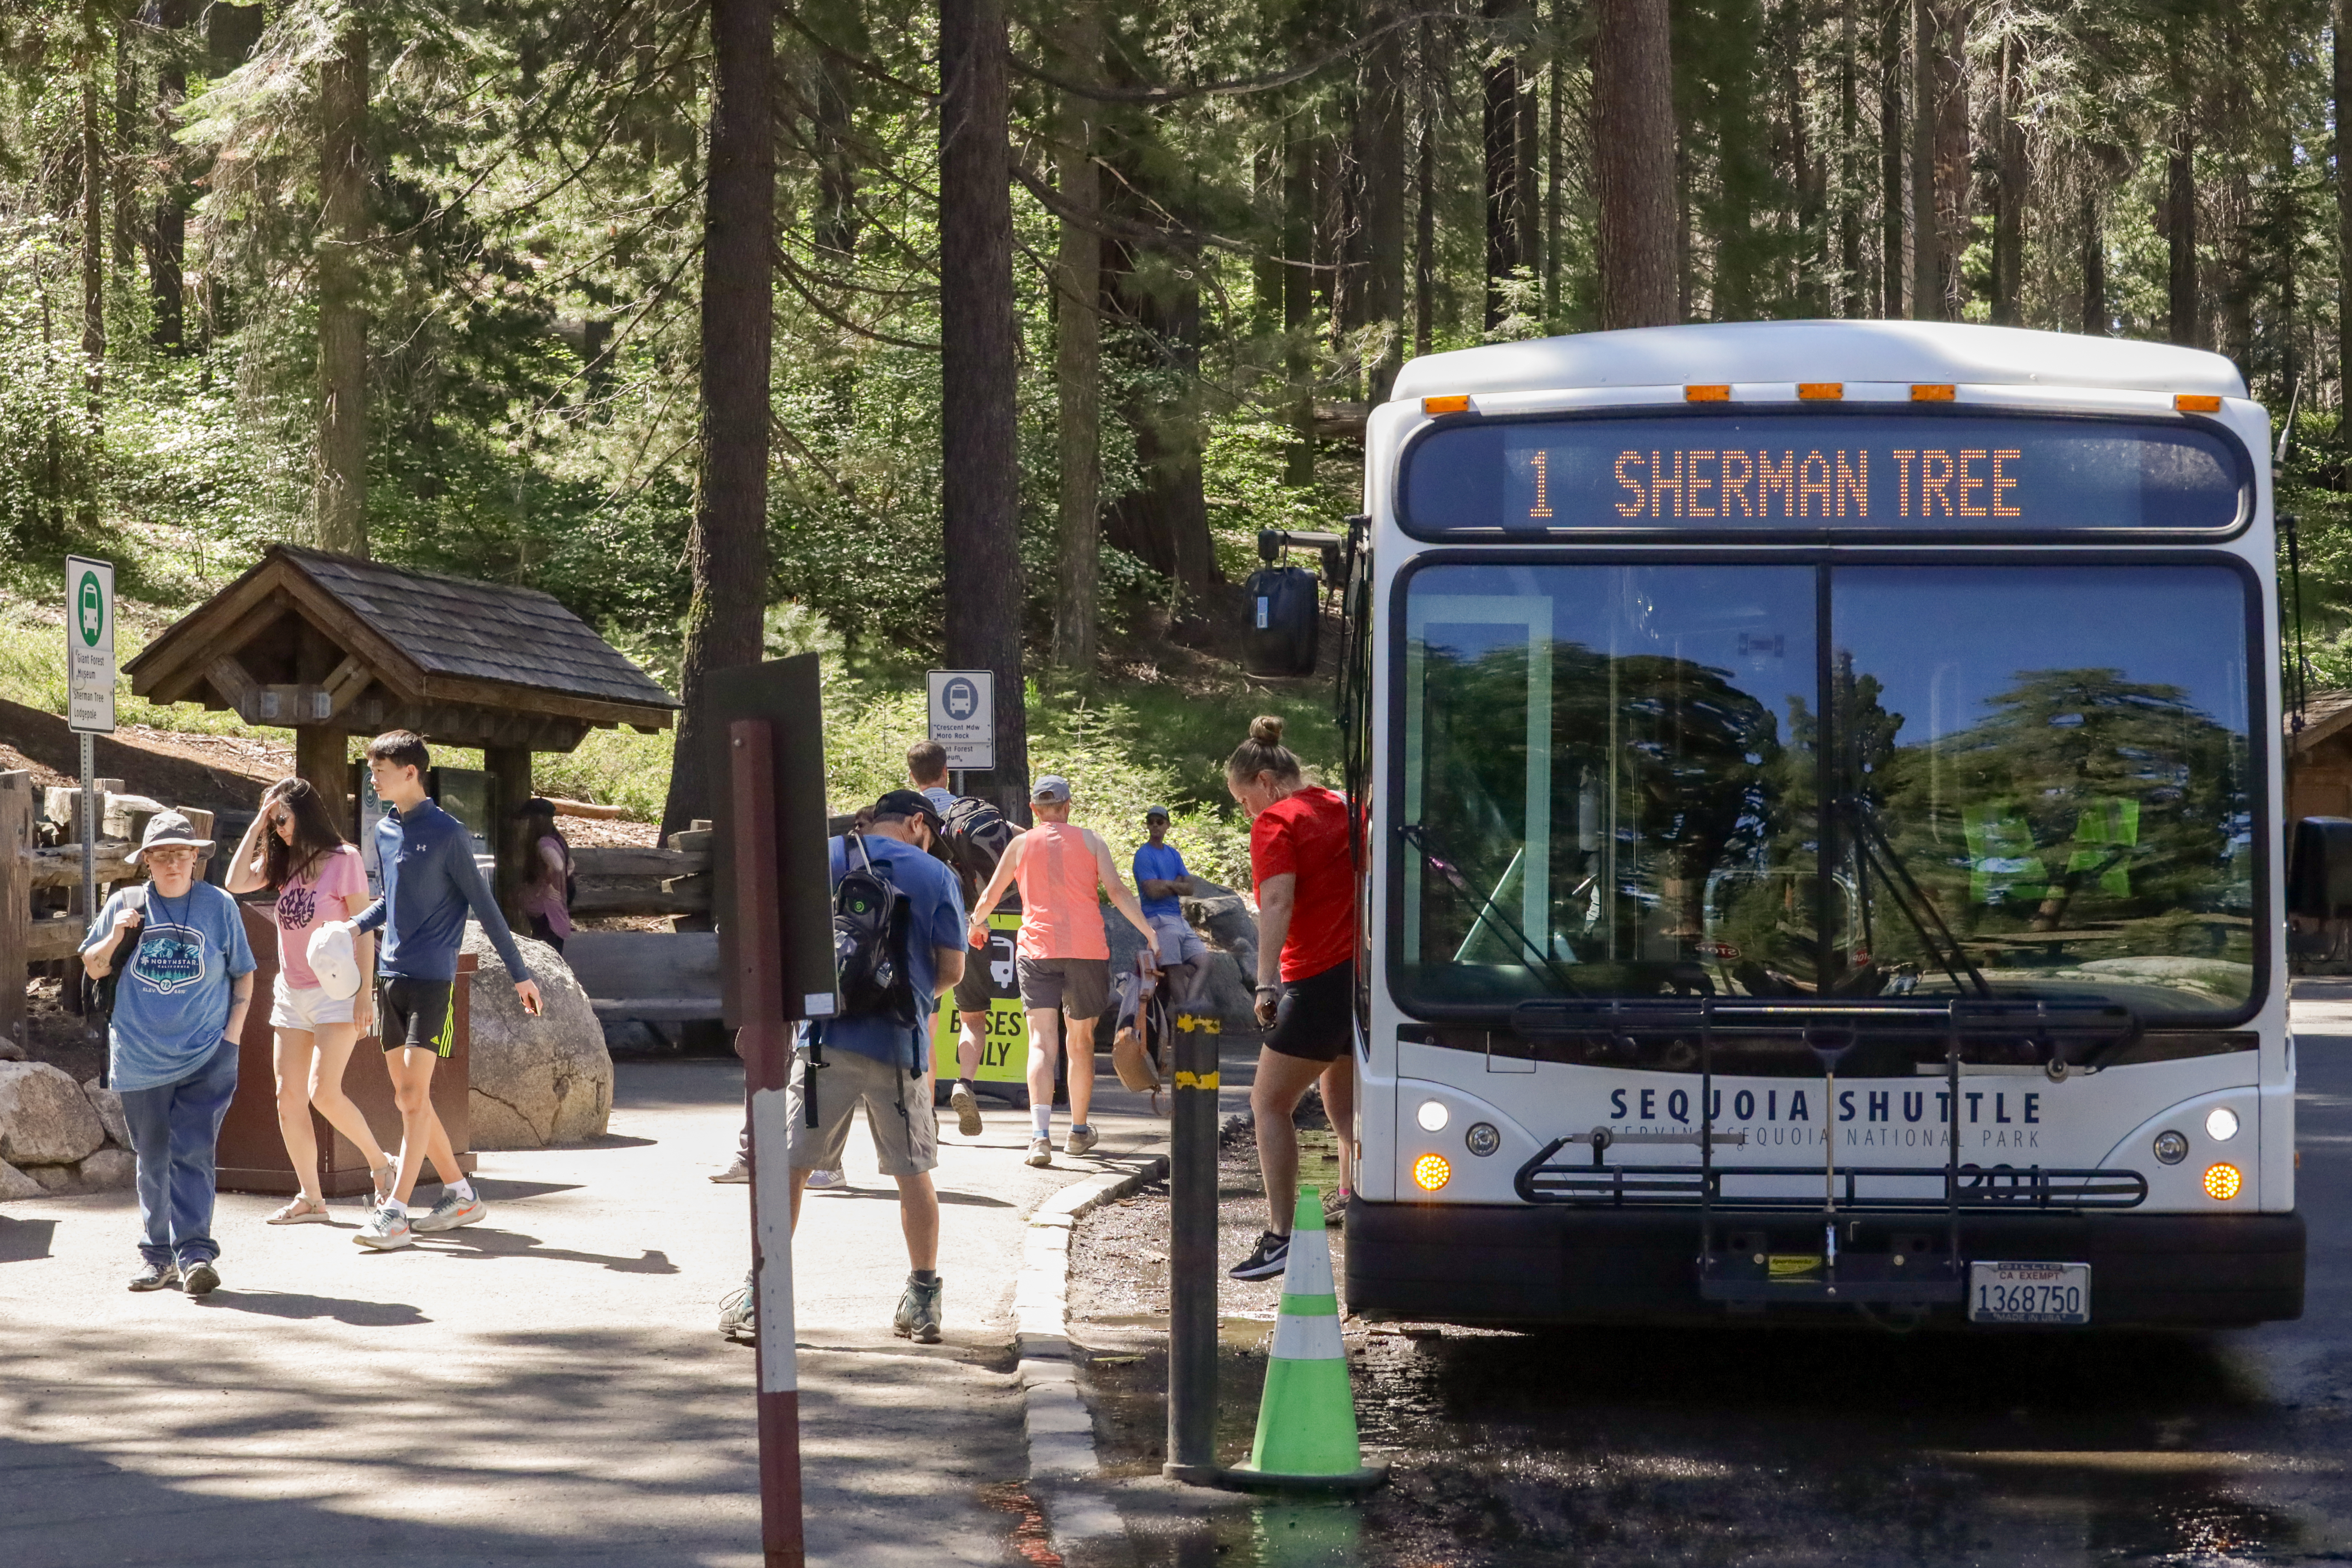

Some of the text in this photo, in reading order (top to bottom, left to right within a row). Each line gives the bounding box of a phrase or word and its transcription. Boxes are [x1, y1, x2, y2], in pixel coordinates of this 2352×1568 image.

[1529, 449, 2021, 517] 1 SHERMAN TREE
[78, 653, 104, 666] Giant Forest
[78, 668, 95, 679] Museum
[74, 691, 104, 702] Sherman Tree
[74, 707, 97, 721] Lodgepole
[950, 1009, 1022, 1036] BSES
[1610, 1088, 2039, 1125] SEQUOIA SHUTTLE
[1847, 1129, 1964, 1147] NATIONAL
[1983, 1131, 2038, 1147] PARK
[1999, 1272, 2060, 1280] CA EXEMPT
[1977, 1284, 2079, 1313] 1368750
